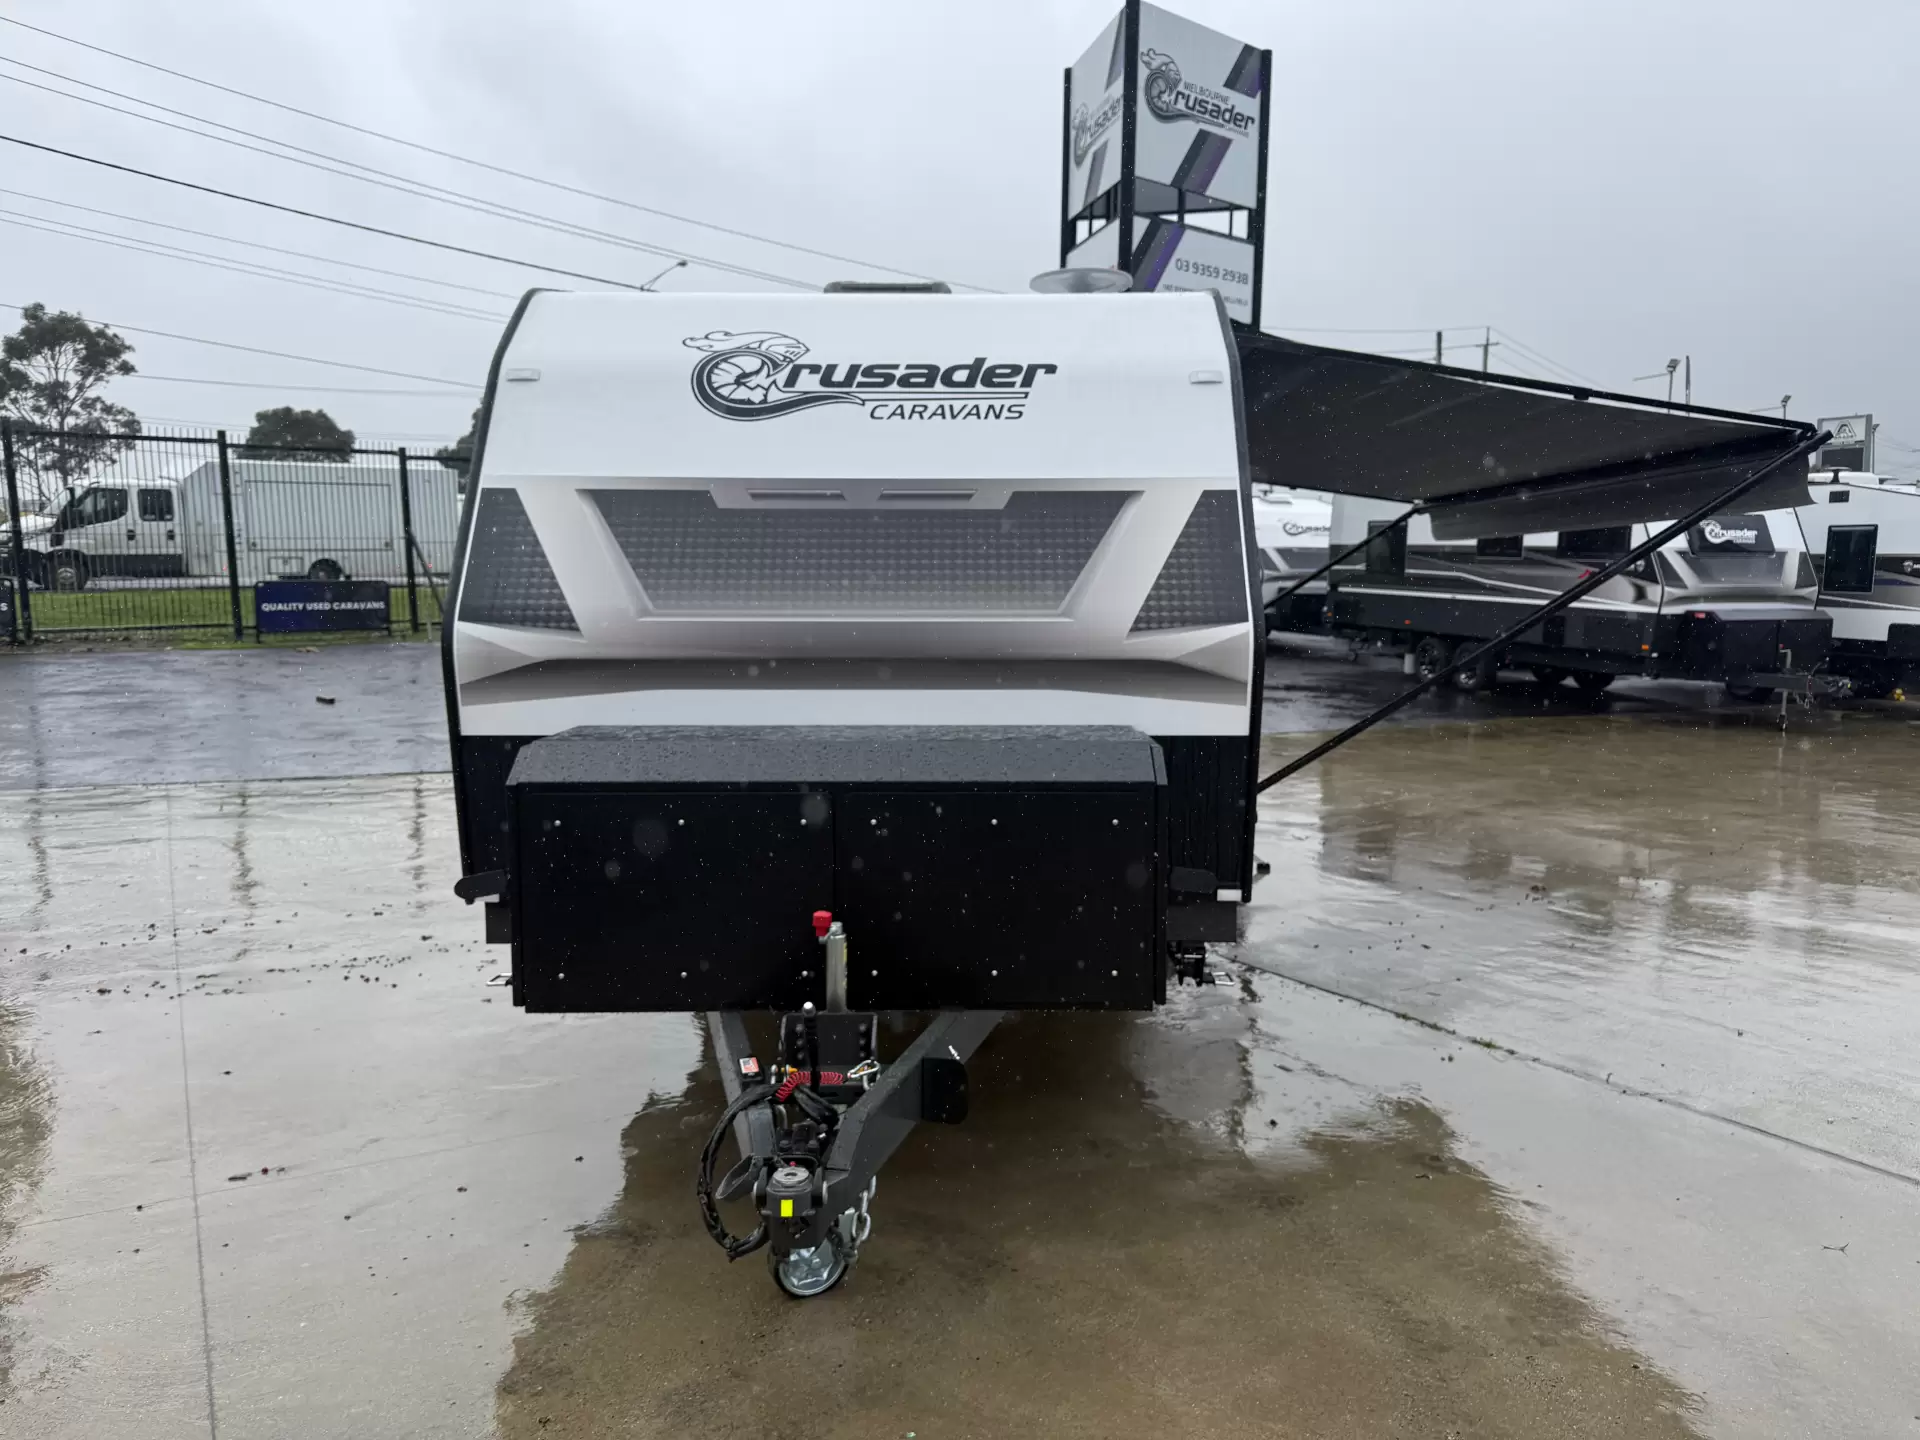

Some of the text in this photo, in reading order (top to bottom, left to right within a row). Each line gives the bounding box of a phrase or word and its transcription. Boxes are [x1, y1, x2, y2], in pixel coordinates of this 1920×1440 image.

[1175, 258, 1190, 273] 03
[1191, 261, 1220, 279] 9359
[869, 403, 1026, 421] CARAVANS
[261, 601, 386, 612] QUALITY USED CARAVANS
